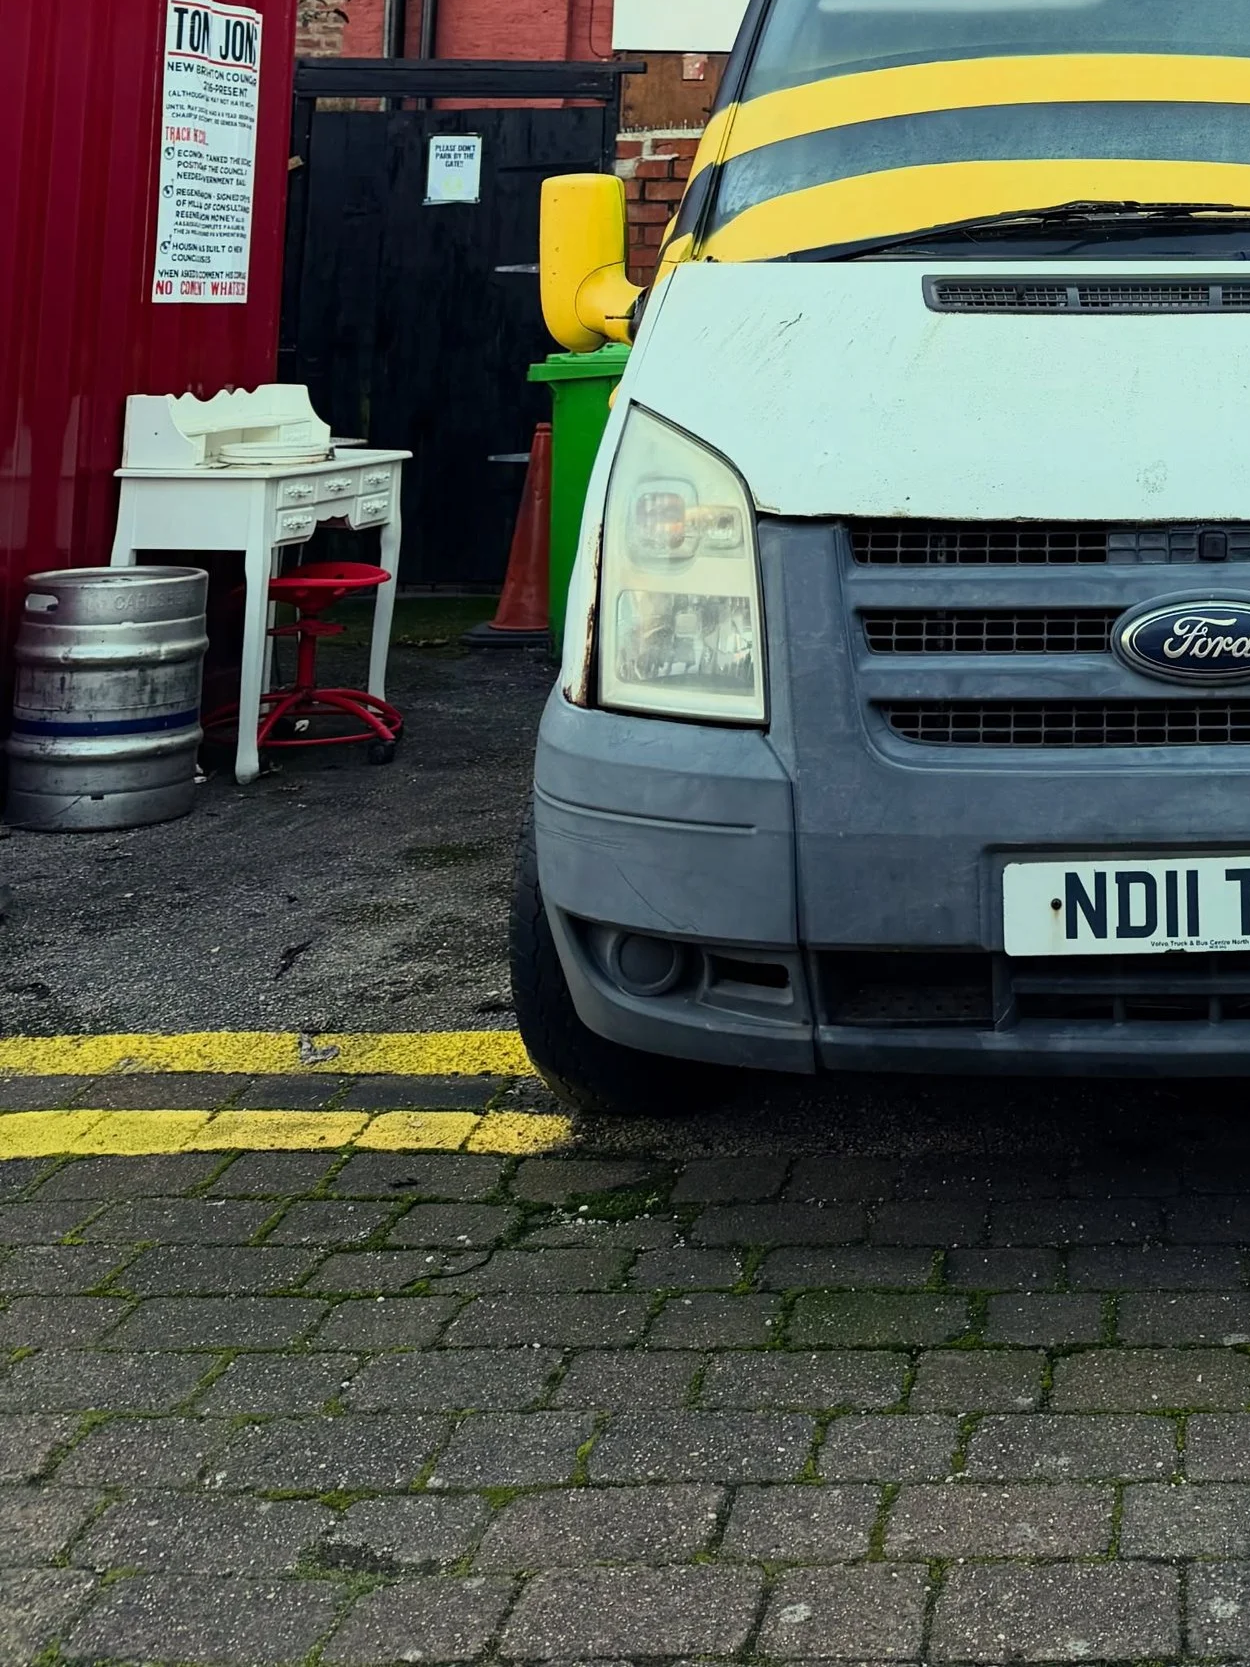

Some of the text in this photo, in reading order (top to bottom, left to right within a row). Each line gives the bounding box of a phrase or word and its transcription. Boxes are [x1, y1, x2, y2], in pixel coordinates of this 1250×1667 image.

[167, 61, 195, 73] NEW
[165, 126, 191, 142] TRACK
[435, 144, 476, 152] PLEASE DON'T
[176, 199, 187, 207] OF
[211, 213, 236, 223] MONEY
[158, 269, 179, 278] WHEN
[155, 280, 173, 295] NO
[1065, 870, 1199, 939] ND11
